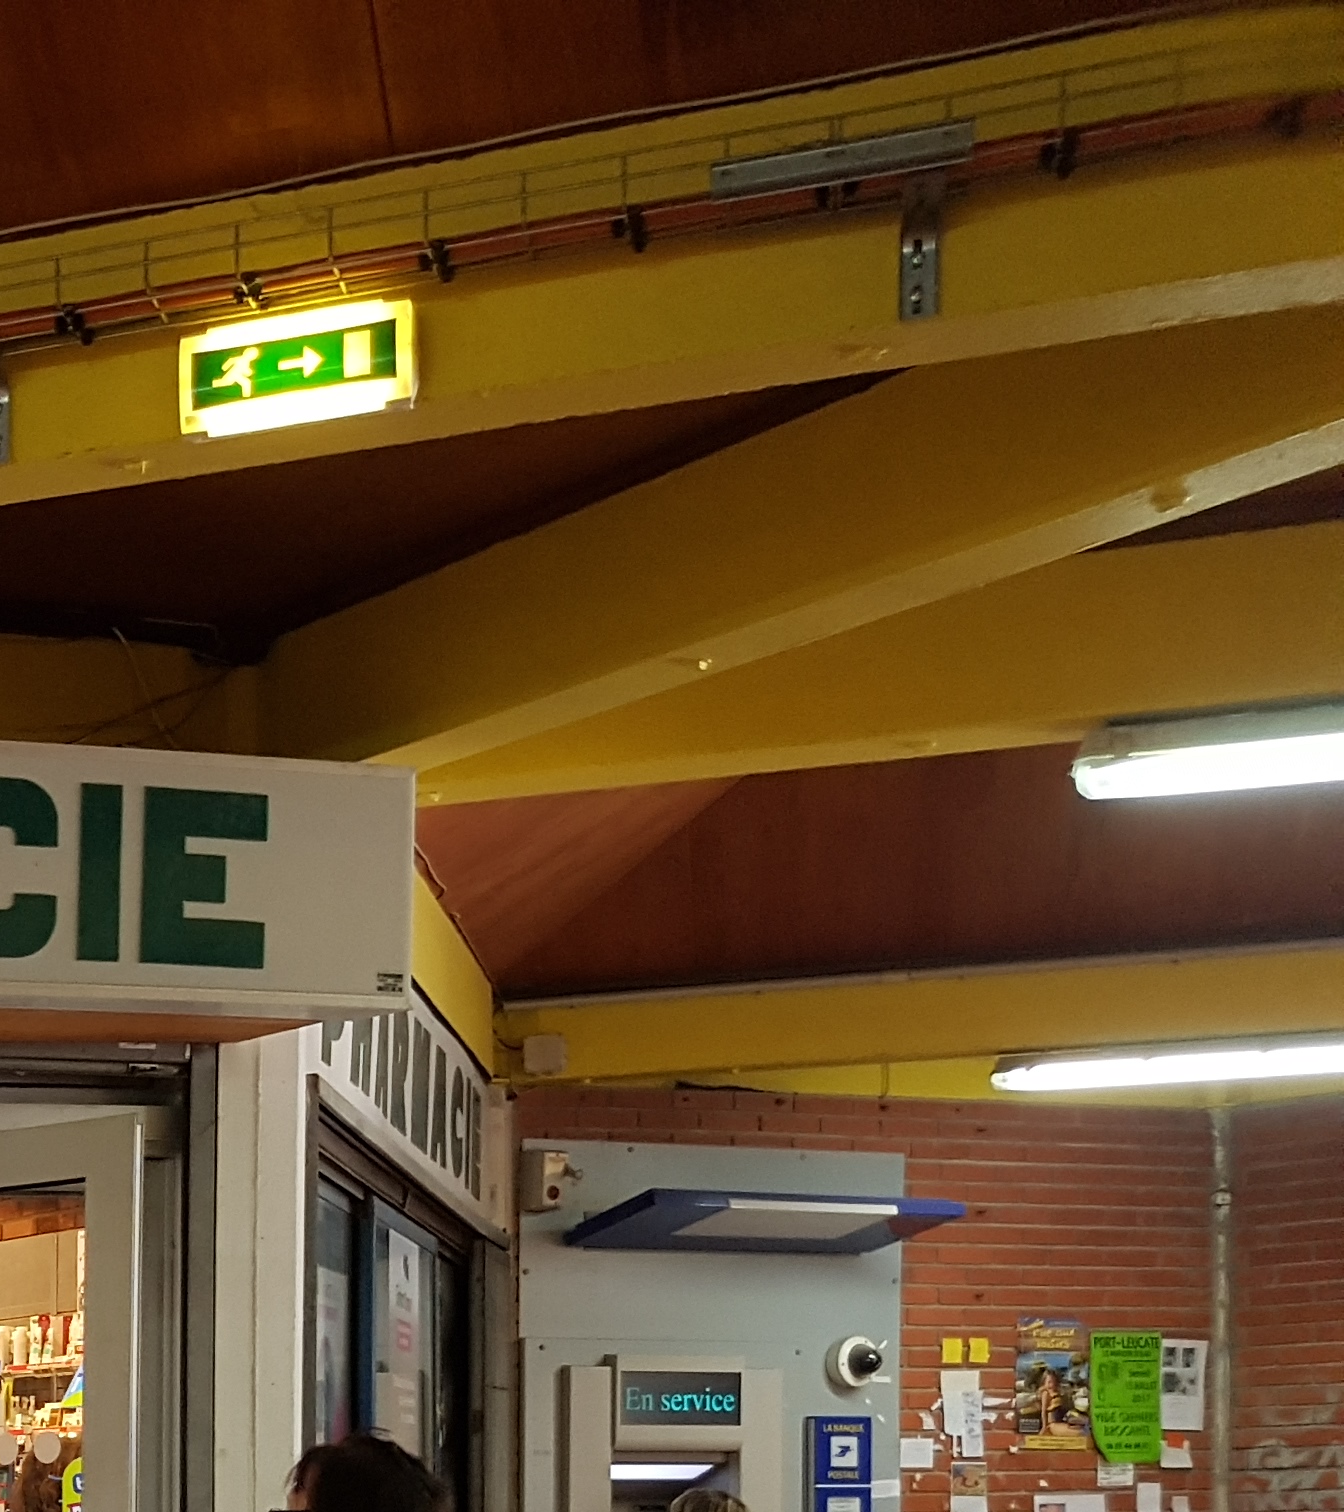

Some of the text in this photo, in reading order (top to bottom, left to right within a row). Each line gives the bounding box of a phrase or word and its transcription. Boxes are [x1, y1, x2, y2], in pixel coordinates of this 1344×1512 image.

[1094, 1336, 1160, 1349] PORT-LEUCATE
[625, 1387, 736, 1412] En service
